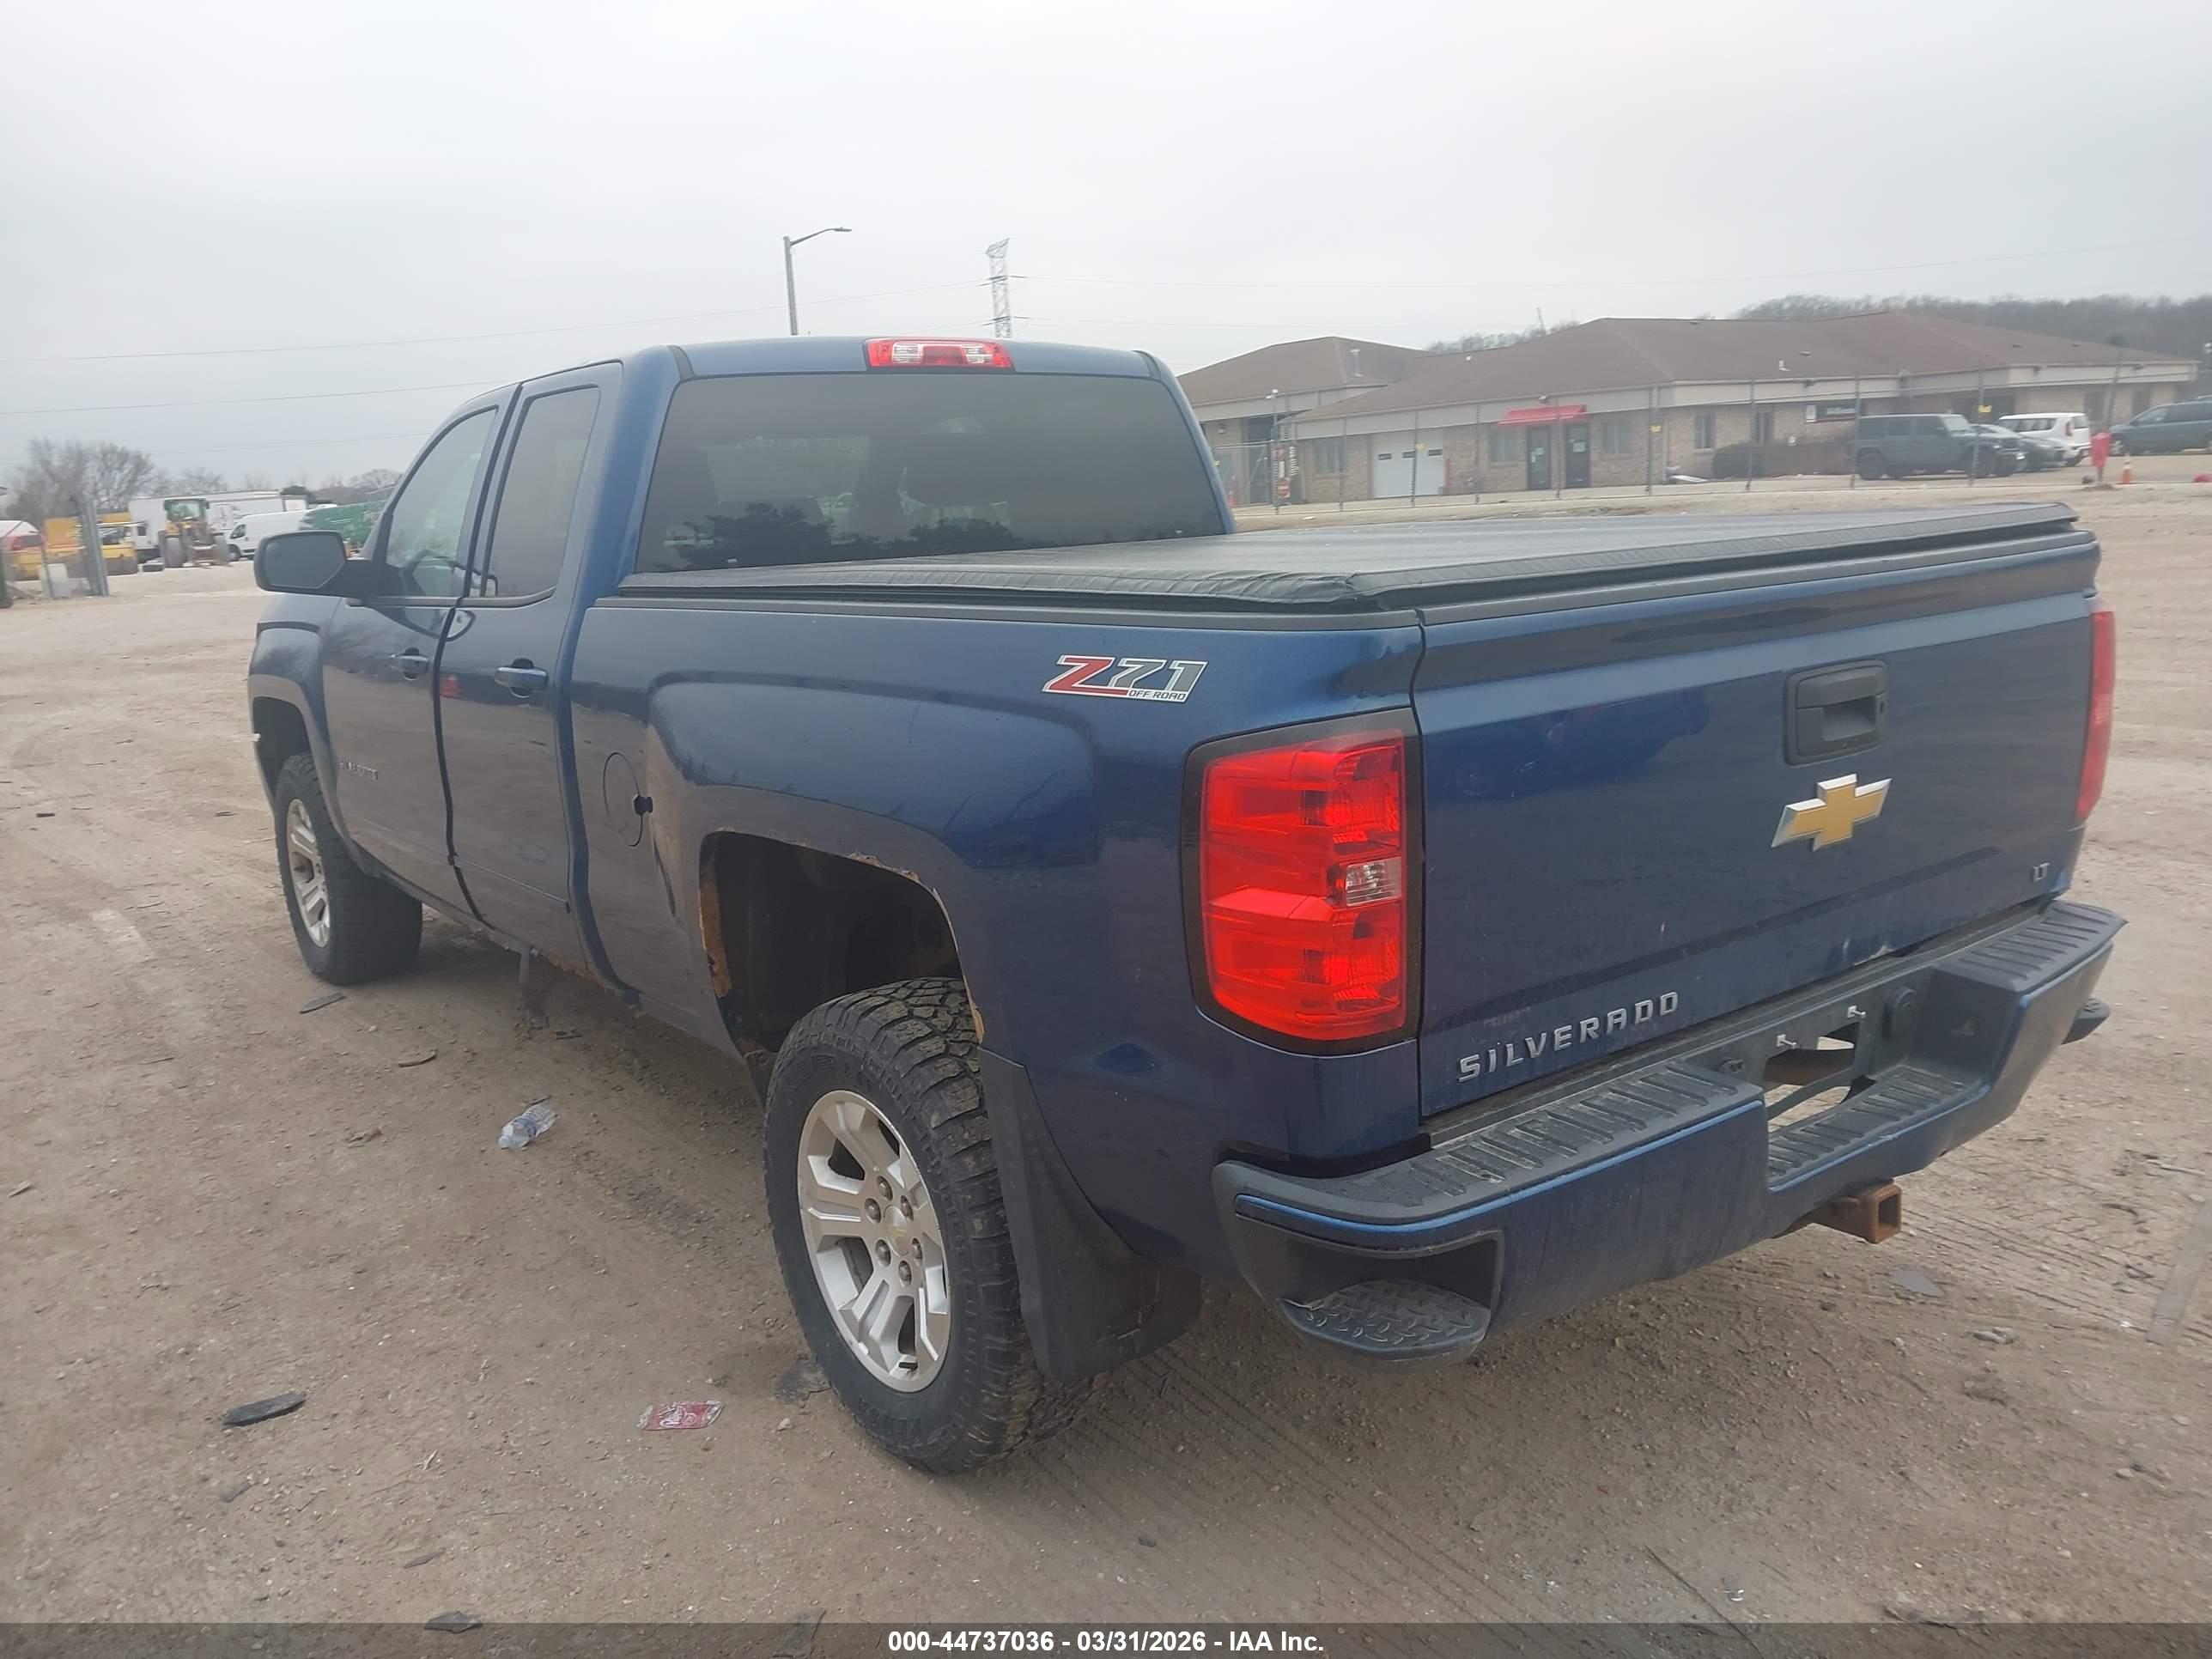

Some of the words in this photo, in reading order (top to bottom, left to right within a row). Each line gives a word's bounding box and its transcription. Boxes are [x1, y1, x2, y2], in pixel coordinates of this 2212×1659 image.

[1042, 655, 1208, 698] Z71
[1128, 690, 1151, 698] OFF
[1152, 691, 1187, 701] ROAD
[2033, 862, 2051, 882] LT
[1458, 991, 1679, 1083] SILVERADO
